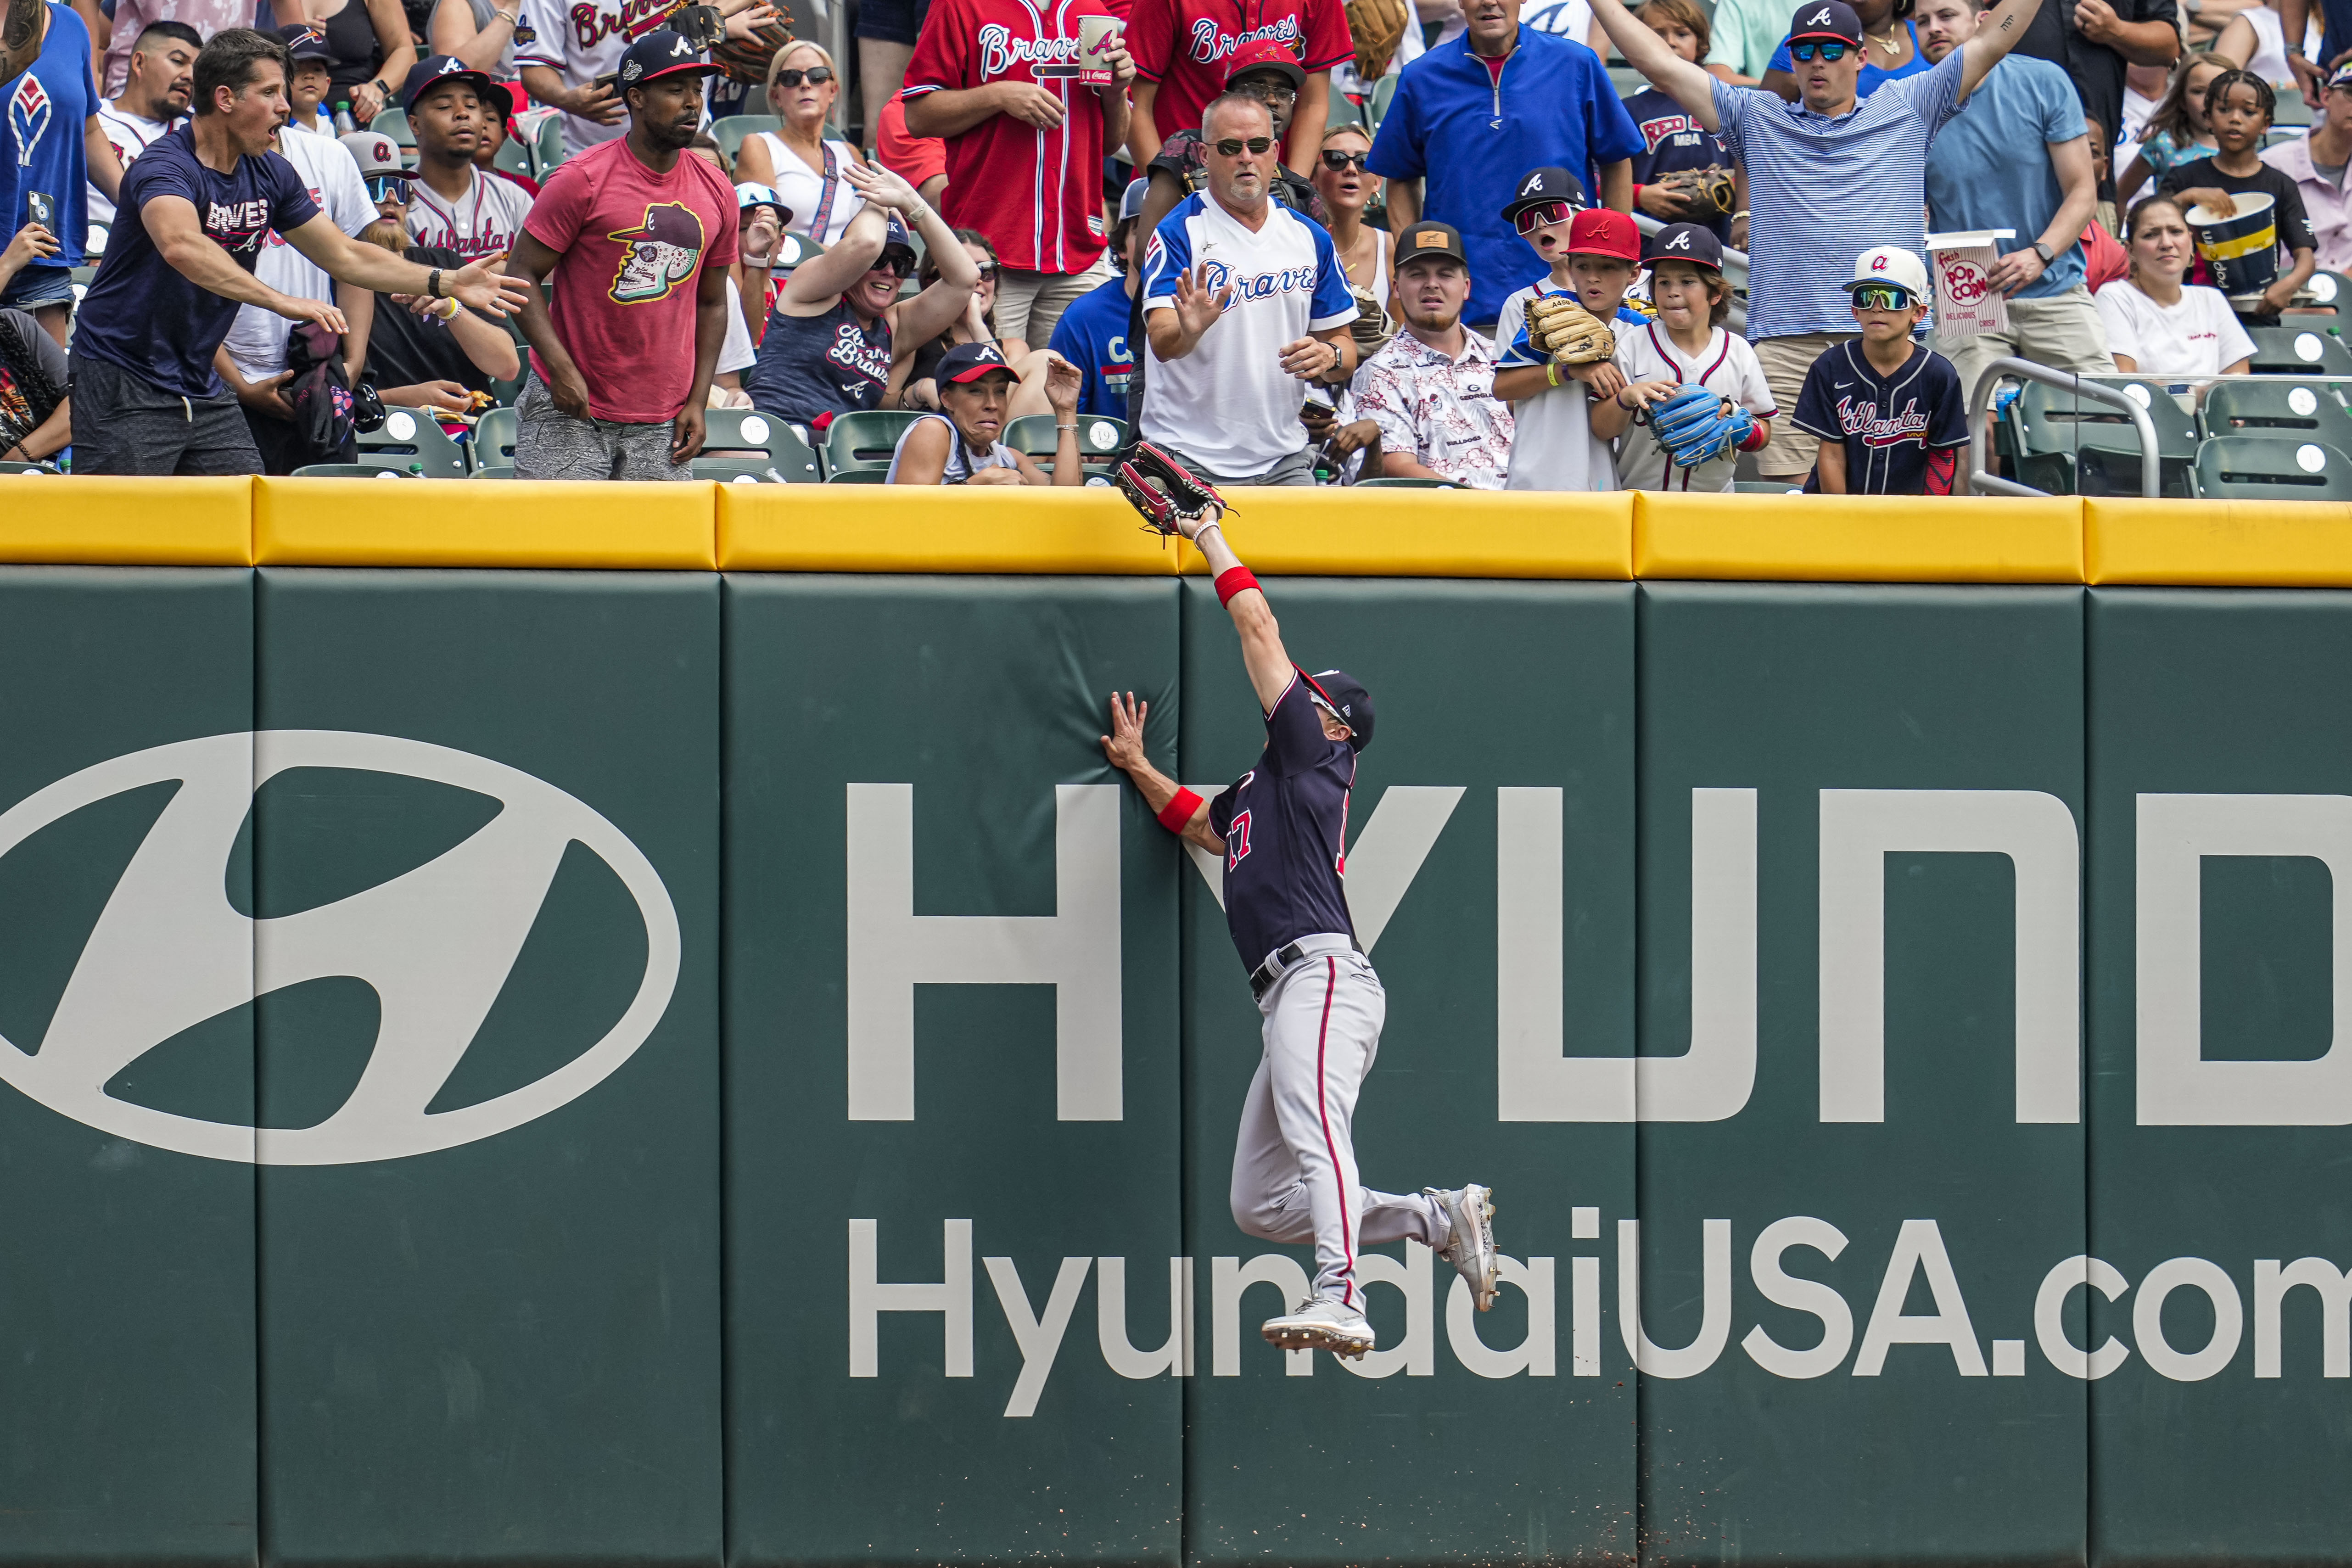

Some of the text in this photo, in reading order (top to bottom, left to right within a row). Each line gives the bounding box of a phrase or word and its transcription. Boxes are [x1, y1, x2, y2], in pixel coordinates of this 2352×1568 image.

[1807, 7, 1831, 26] A
[670, 35, 693, 57] A
[979, 23, 1079, 83] Brav
[439, 57, 462, 74] A
[1673, 133, 1702, 146] MBA
[1521, 173, 1543, 196] A
[1586, 219, 1610, 239] A
[232, 229, 261, 252] A
[1665, 230, 1690, 250] A
[1938, 251, 1959, 269] fresh
[1947, 266, 1975, 287] POP
[1952, 277, 1987, 300] CORN
[1552, 300, 1570, 308] A450
[975, 346, 998, 361] A
[842, 381, 869, 399] A
[1836, 395, 1926, 436] Atlanta
[1098, 430, 1110, 441] 19
[1446, 436, 1482, 446] BULLDOGS
